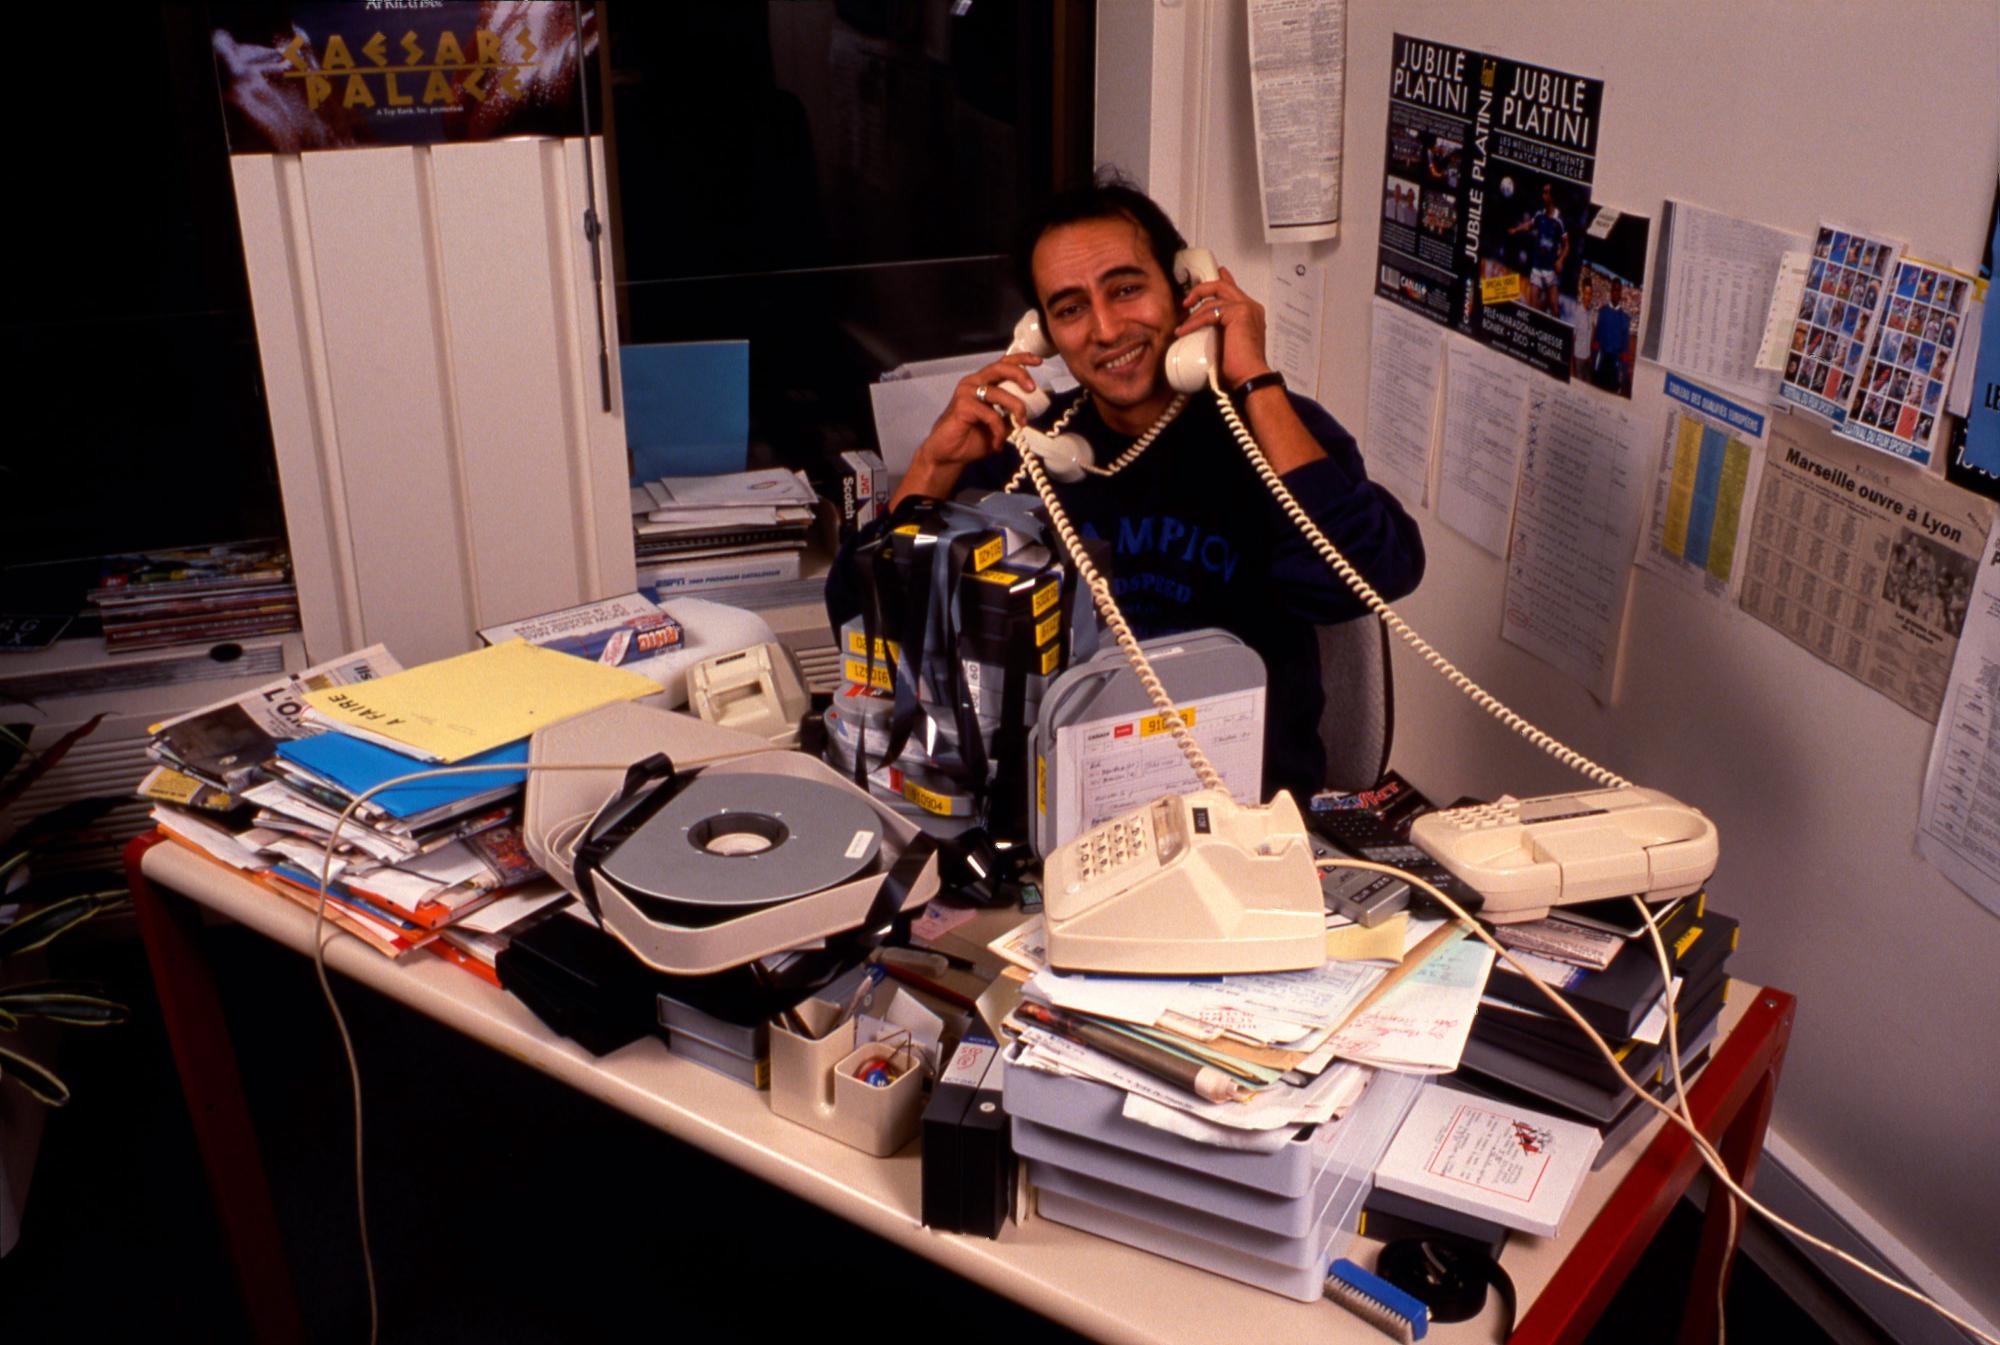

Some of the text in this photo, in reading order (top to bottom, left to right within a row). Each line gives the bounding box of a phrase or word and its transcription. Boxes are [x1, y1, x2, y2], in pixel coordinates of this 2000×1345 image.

[283, 27, 538, 71] CAESARS
[306, 66, 525, 110] PALACE
[1393, 68, 1469, 114] PLATINI
[1472, 89, 1494, 183] PLATINI
[1501, 97, 1590, 148] PLATINI
[843, 476, 855, 520] Scotch
[1785, 447, 1856, 493] Marseille
[1858, 485, 1904, 515] ouvre
[1906, 504, 1918, 523] à
[1921, 511, 1962, 544] Lyon
[327, 693, 386, 721] FAIRE
